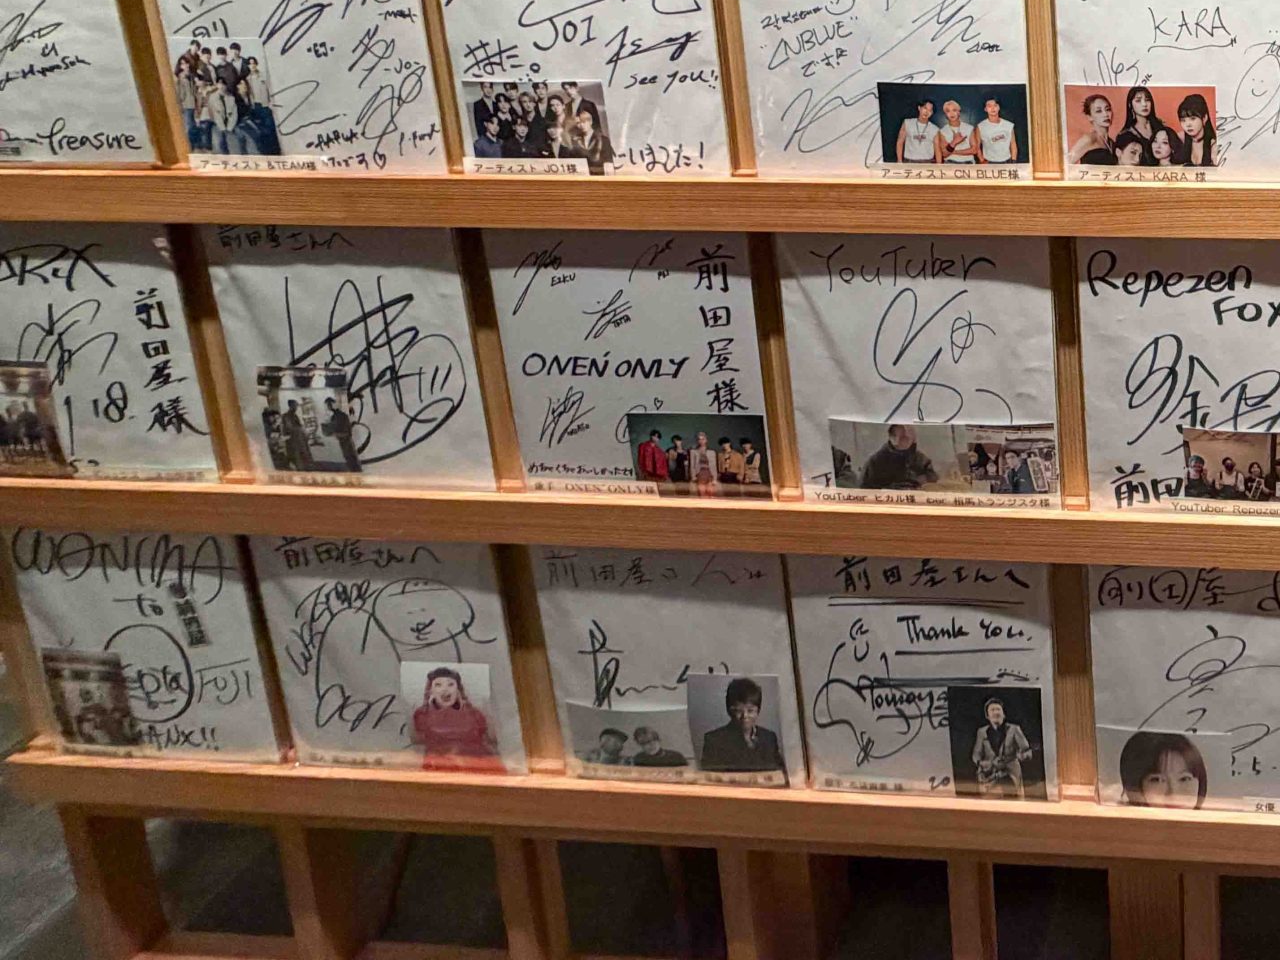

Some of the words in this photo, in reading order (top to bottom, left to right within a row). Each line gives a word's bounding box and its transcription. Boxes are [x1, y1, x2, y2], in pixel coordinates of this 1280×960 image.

[200, 160, 260, 171] アーティスト
[474, 164, 537, 173] アーティスト
[881, 168, 946, 179] アーティスト
[954, 169, 971, 179] CN
[976, 169, 1019, 179] BLUE様
[1079, 170, 1146, 181] アーティスト
[1152, 171, 1189, 181] KARA
[1195, 171, 1207, 182] 様
[686, 243, 749, 414] 前田屋様
[814, 491, 867, 502] YouTuber
